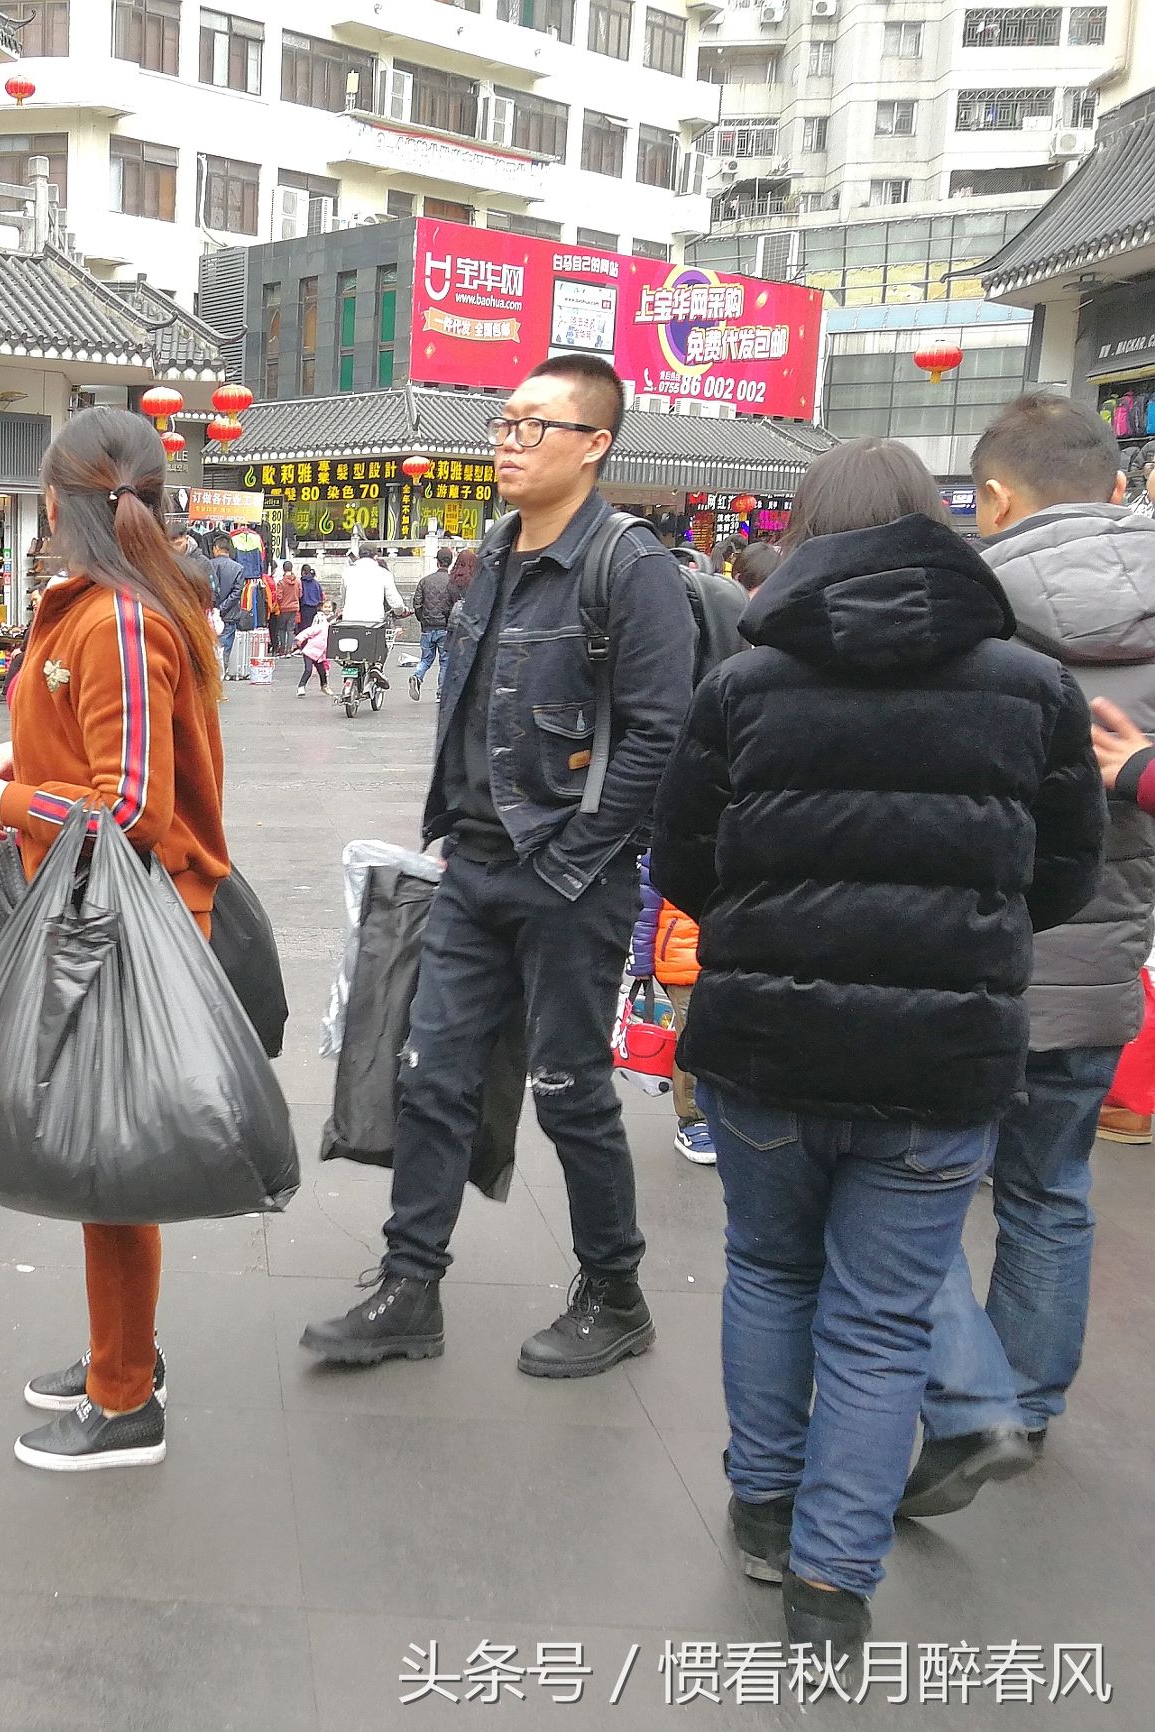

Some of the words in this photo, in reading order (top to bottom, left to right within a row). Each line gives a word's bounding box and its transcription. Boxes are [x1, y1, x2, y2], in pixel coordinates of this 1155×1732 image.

[553, 254, 619, 278] 白马自己的网站
[455, 257, 524, 297] 宝华网
[455, 292, 522, 311] www.baohua.com
[634, 284, 745, 323] 上宝华网采购
[686, 325, 789, 366] 免费代发包邮
[658, 381, 680, 394] 0755
[680, 375, 702, 396] 86
[703, 376, 734, 400] 002
[736, 379, 766, 403] 002
[336, 461, 397, 481] 髮型設計
[301, 487, 320, 501] 80
[327, 486, 355, 499] 染色
[359, 484, 380, 498] 70
[475, 485, 492, 501] 80
[271, 510, 282, 522] 80
[342, 507, 370, 530] 30
[462, 509, 478, 529] 20
